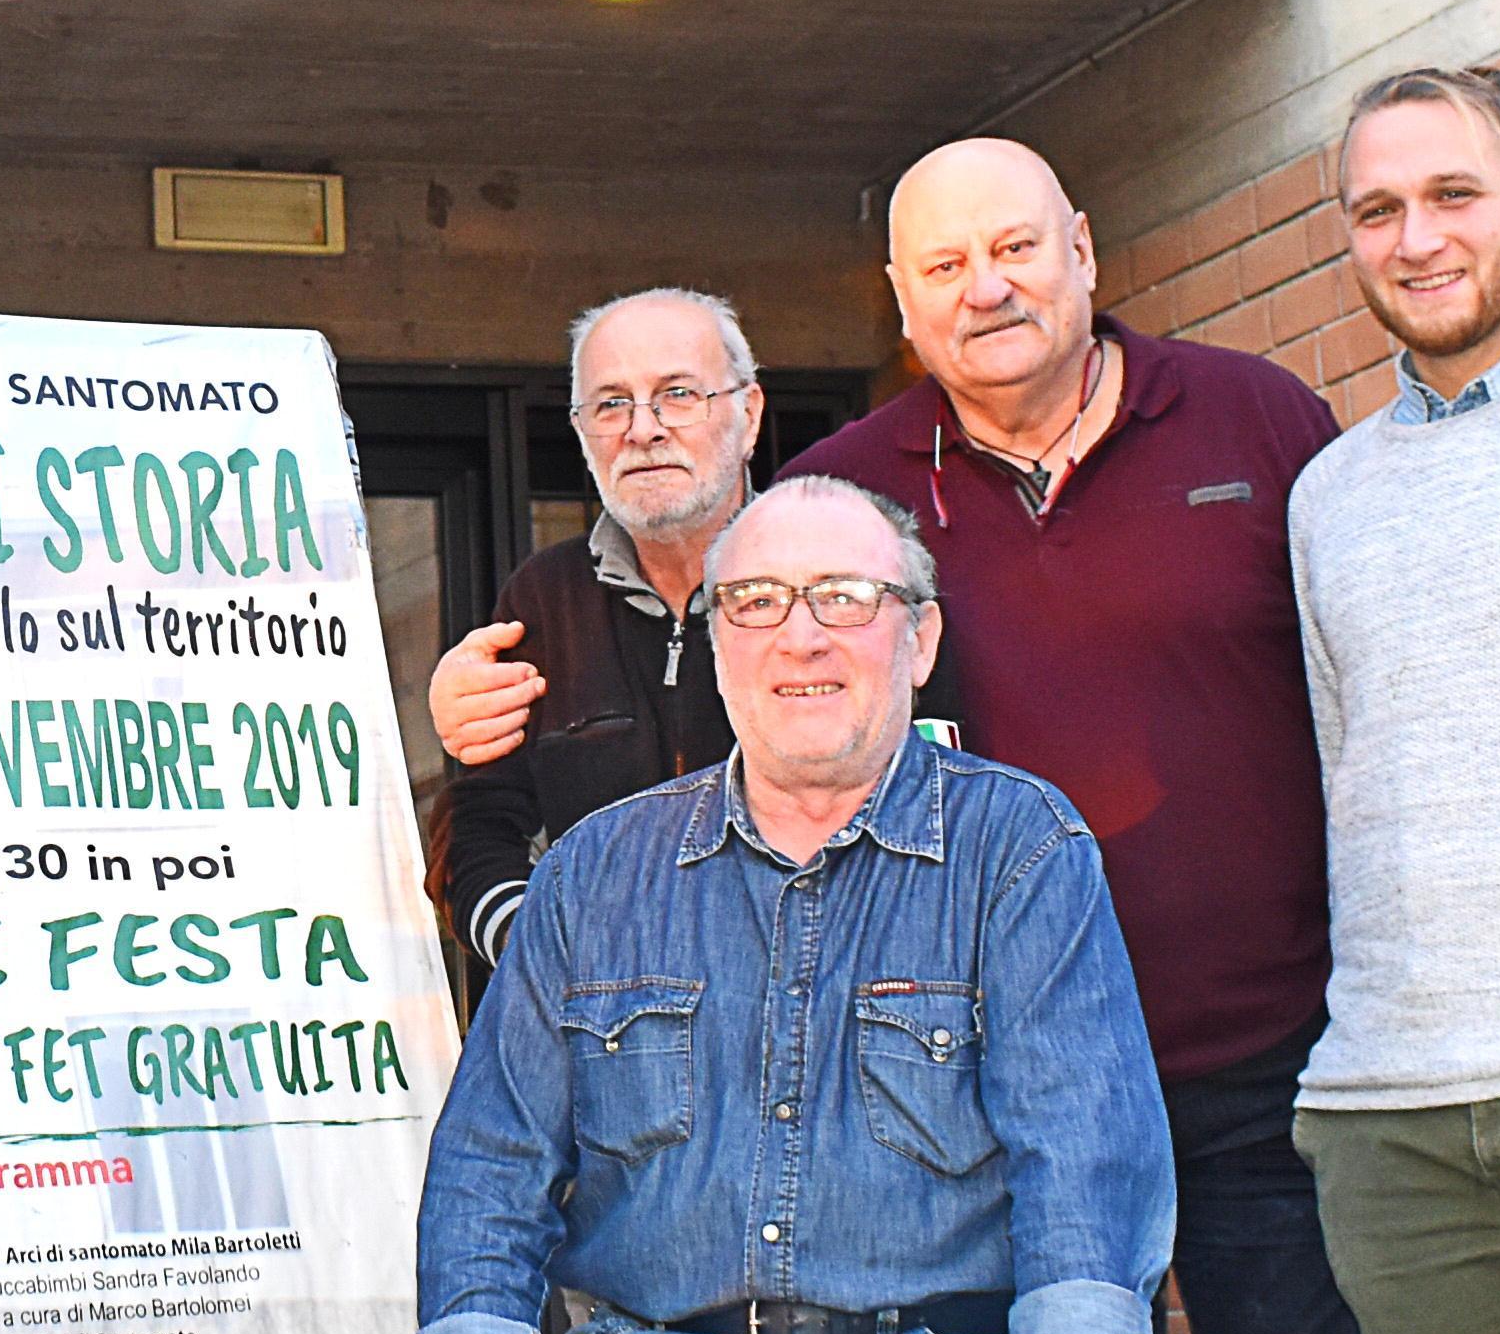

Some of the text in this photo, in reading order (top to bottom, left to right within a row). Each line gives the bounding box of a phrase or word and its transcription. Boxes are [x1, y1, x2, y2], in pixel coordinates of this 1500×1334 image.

[8, 372, 280, 416] SANTOMATO
[36, 446, 324, 580] STORIA
[59, 594, 124, 652] sul
[143, 589, 349, 659] territorio
[231, 701, 360, 813] 2019
[88, 844, 130, 881] in
[153, 845, 236, 890] poi
[41, 907, 370, 992] FESTA
[128, 1020, 410, 1097] GRATUITA
[6, 1244, 43, 1266] Arci
[47, 1243, 64, 1264] di
[69, 1238, 167, 1262] santomato
[171, 1236, 211, 1258] Mila
[215, 1229, 302, 1255] Bartoletti
[92, 1267, 158, 1292] Sandra
[163, 1264, 261, 1288] Favolando
[3, 1312, 15, 1328] a
[21, 1307, 62, 1327] cura
[67, 1302, 84, 1324] di
[89, 1299, 148, 1323] Marco
[151, 1292, 252, 1319] Bartolomei
